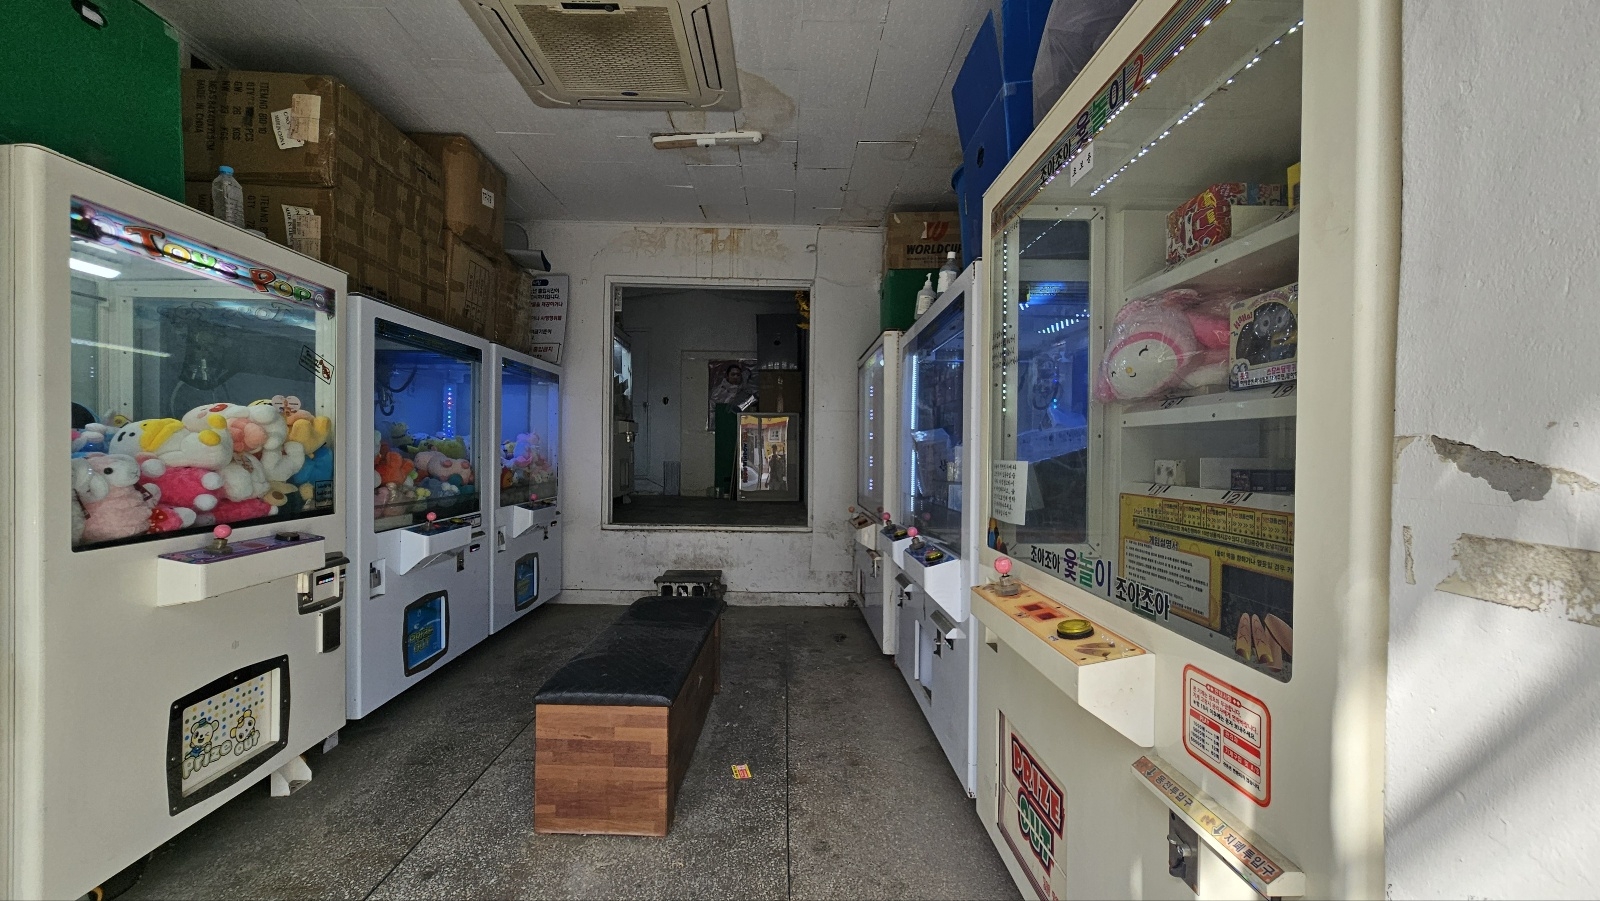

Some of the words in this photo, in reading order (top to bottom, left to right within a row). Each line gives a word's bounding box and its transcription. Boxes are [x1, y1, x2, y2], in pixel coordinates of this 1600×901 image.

[196, 80, 206, 98] MADE
[246, 82, 254, 95] QTY
[194, 114, 204, 133] CHINA
[1040, 139, 1071, 184] 조아조아
[1076, 67, 1126, 150] 윷놀이
[1133, 54, 1144, 91] 2
[246, 128, 254, 142] PCS
[247, 195, 256, 208] QTY
[1228, 492, 1240, 504] 2
[1149, 535, 1179, 550] 게임설명서
[1030, 544, 1060, 574] 조아조아
[1063, 547, 1112, 596] 윷놀이
[1116, 577, 1170, 620] 조아조아
[1013, 740, 1061, 828] PRIZE
[1156, 775, 1194, 807] 동전투입구
[1019, 794, 1052, 866] OUT
[1224, 833, 1276, 876] 지폐투입구
